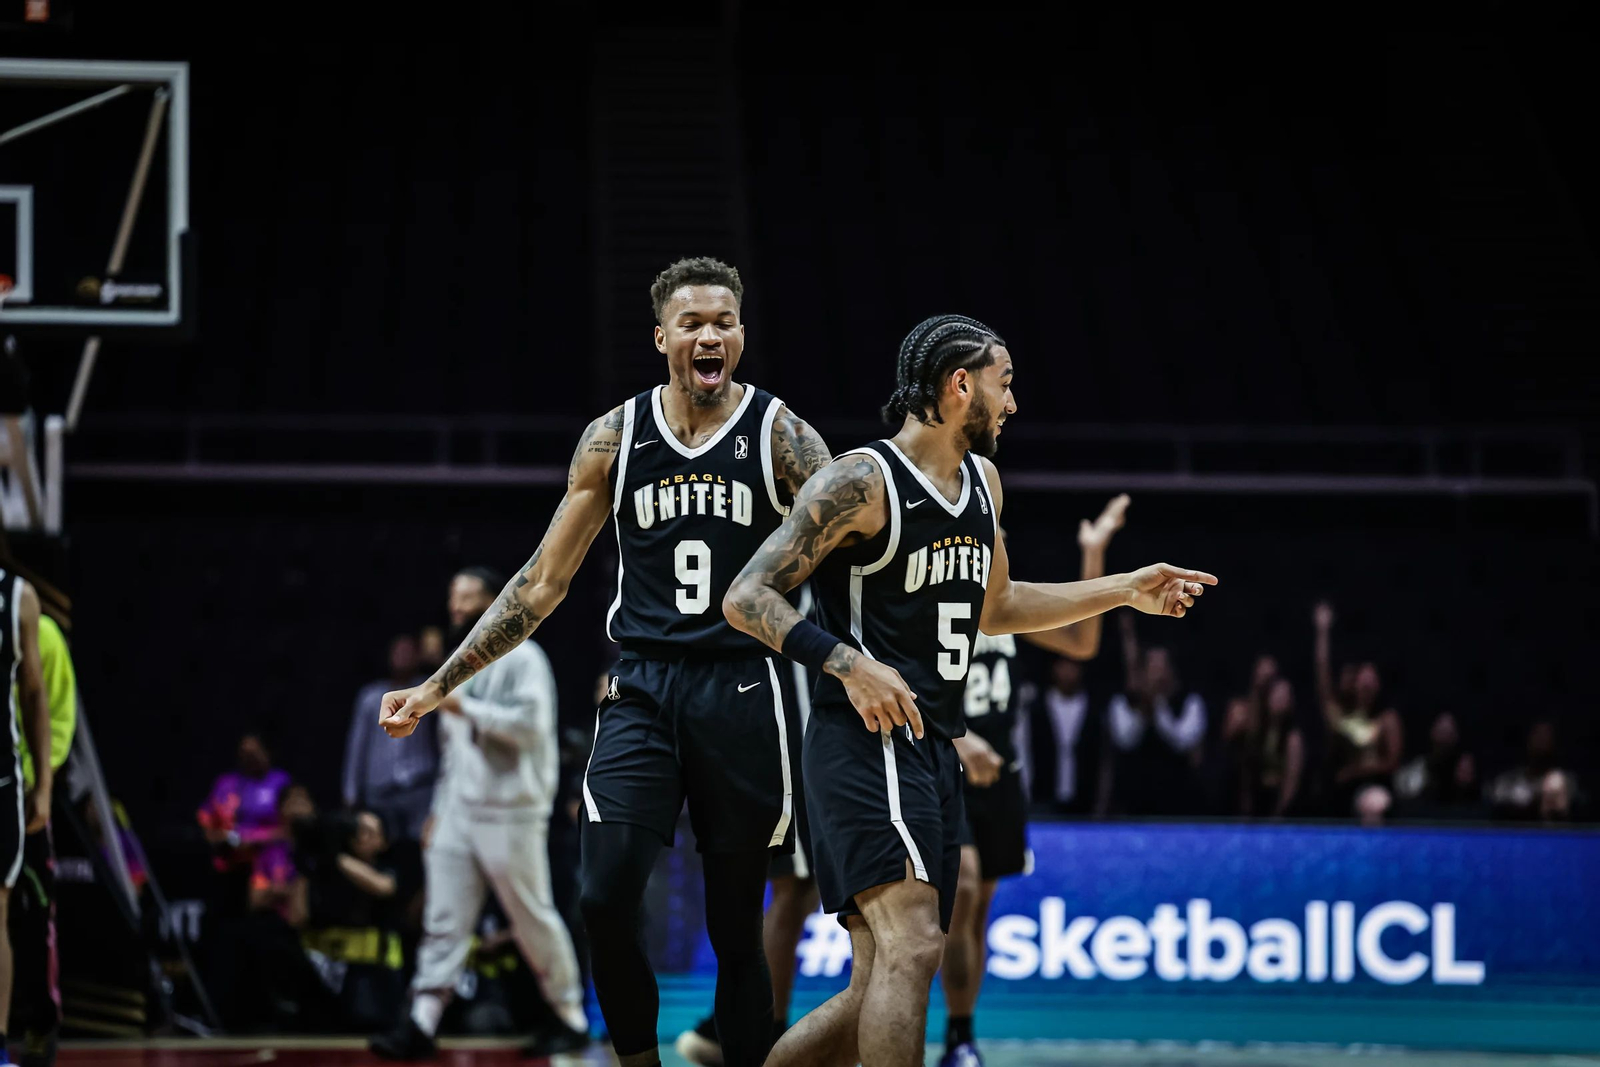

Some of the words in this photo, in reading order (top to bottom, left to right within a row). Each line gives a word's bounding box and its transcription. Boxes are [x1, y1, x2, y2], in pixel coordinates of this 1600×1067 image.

[634, 480, 753, 530] UNITED
[660, 473, 726, 487] NBAGL
[904, 543, 992, 594] UNITED
[933, 536, 980, 551] NBAGL
[674, 540, 712, 615] 9
[937, 602, 972, 681] 5
[963, 657, 1012, 718] 24
[795, 896, 1486, 985] #sketballCL
